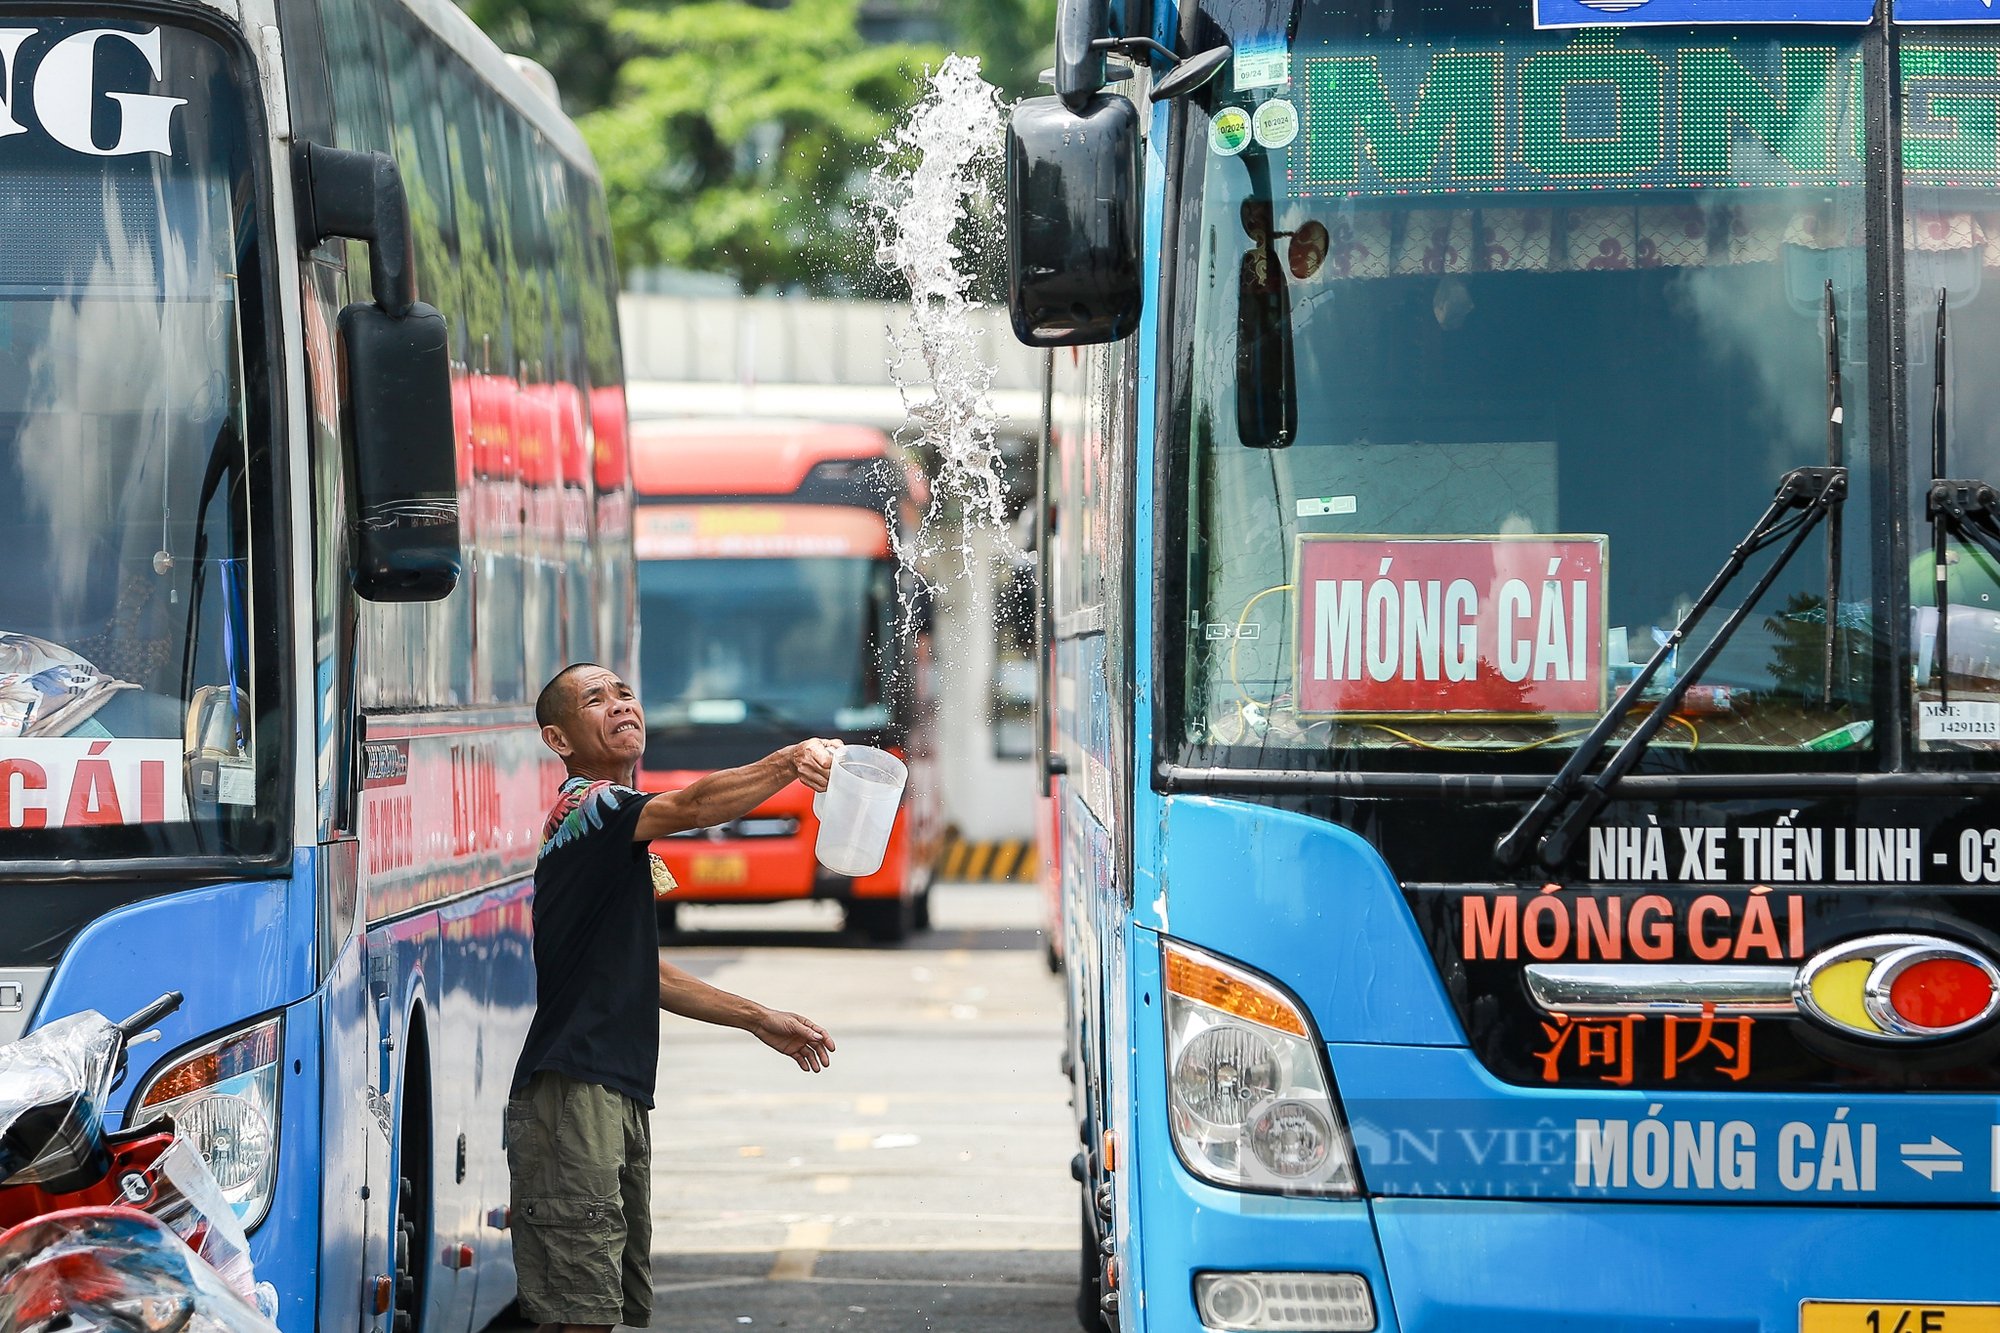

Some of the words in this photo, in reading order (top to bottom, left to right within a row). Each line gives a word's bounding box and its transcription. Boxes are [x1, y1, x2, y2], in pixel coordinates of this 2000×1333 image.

[1240, 70, 1262, 80] 09/24
[1264, 117, 1289, 128] 10/2024
[1314, 557, 1478, 682] MÓNG
[1498, 557, 1587, 682] CÁI
[1926, 706, 1961, 717] MST:
[1941, 722, 1996, 733] 14291213
[0, 741, 164, 829] CÁI
[1589, 814, 1668, 881] NHÀ
[1679, 827, 1727, 881] XE
[1738, 809, 1822, 881] TIẾN
[1835, 828, 1921, 882] LINH
[1462, 883, 1674, 960] MÓNG
[1688, 885, 1805, 960] CÁI
[1533, 1002, 1756, 1086] 河内
[1575, 1103, 1757, 1190] MÓNG
[1777, 1107, 1877, 1192] CÁI
